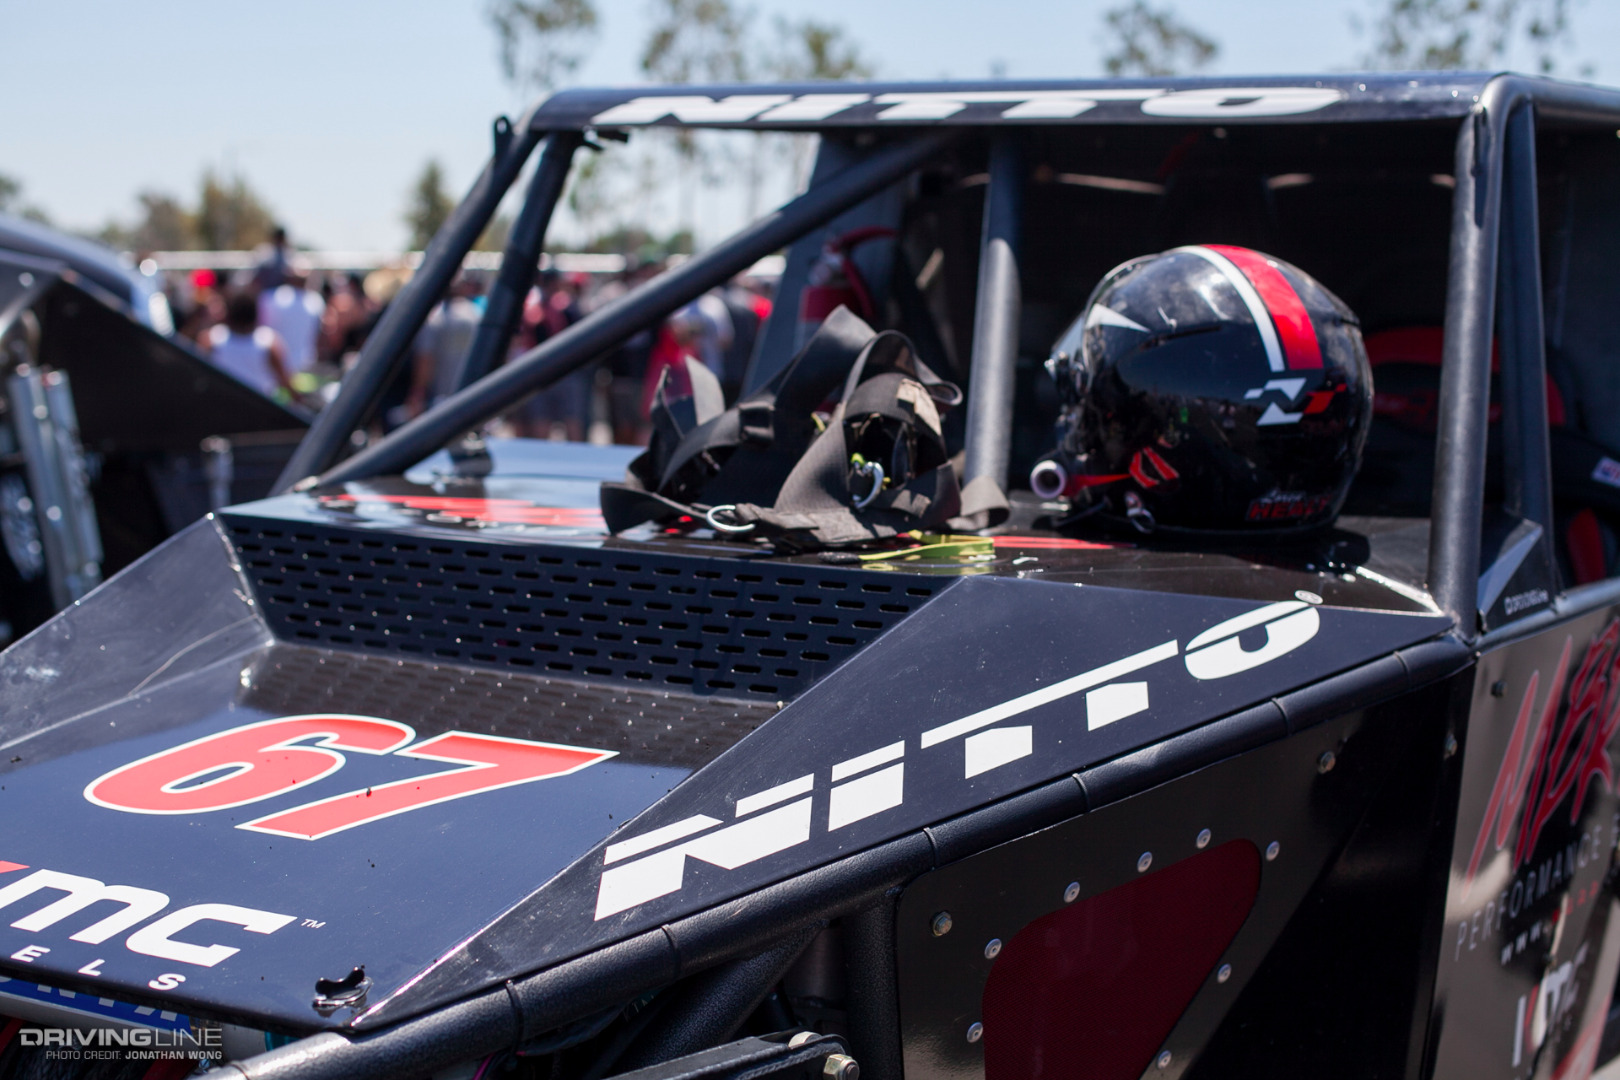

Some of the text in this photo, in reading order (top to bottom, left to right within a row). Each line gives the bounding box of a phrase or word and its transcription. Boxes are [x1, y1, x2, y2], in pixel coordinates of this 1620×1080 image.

[593, 87, 1342, 124] NITTO
[83, 714, 620, 840] 67
[594, 599, 1320, 921] NITTO
[1455, 824, 1602, 962] PERFORMANCE
